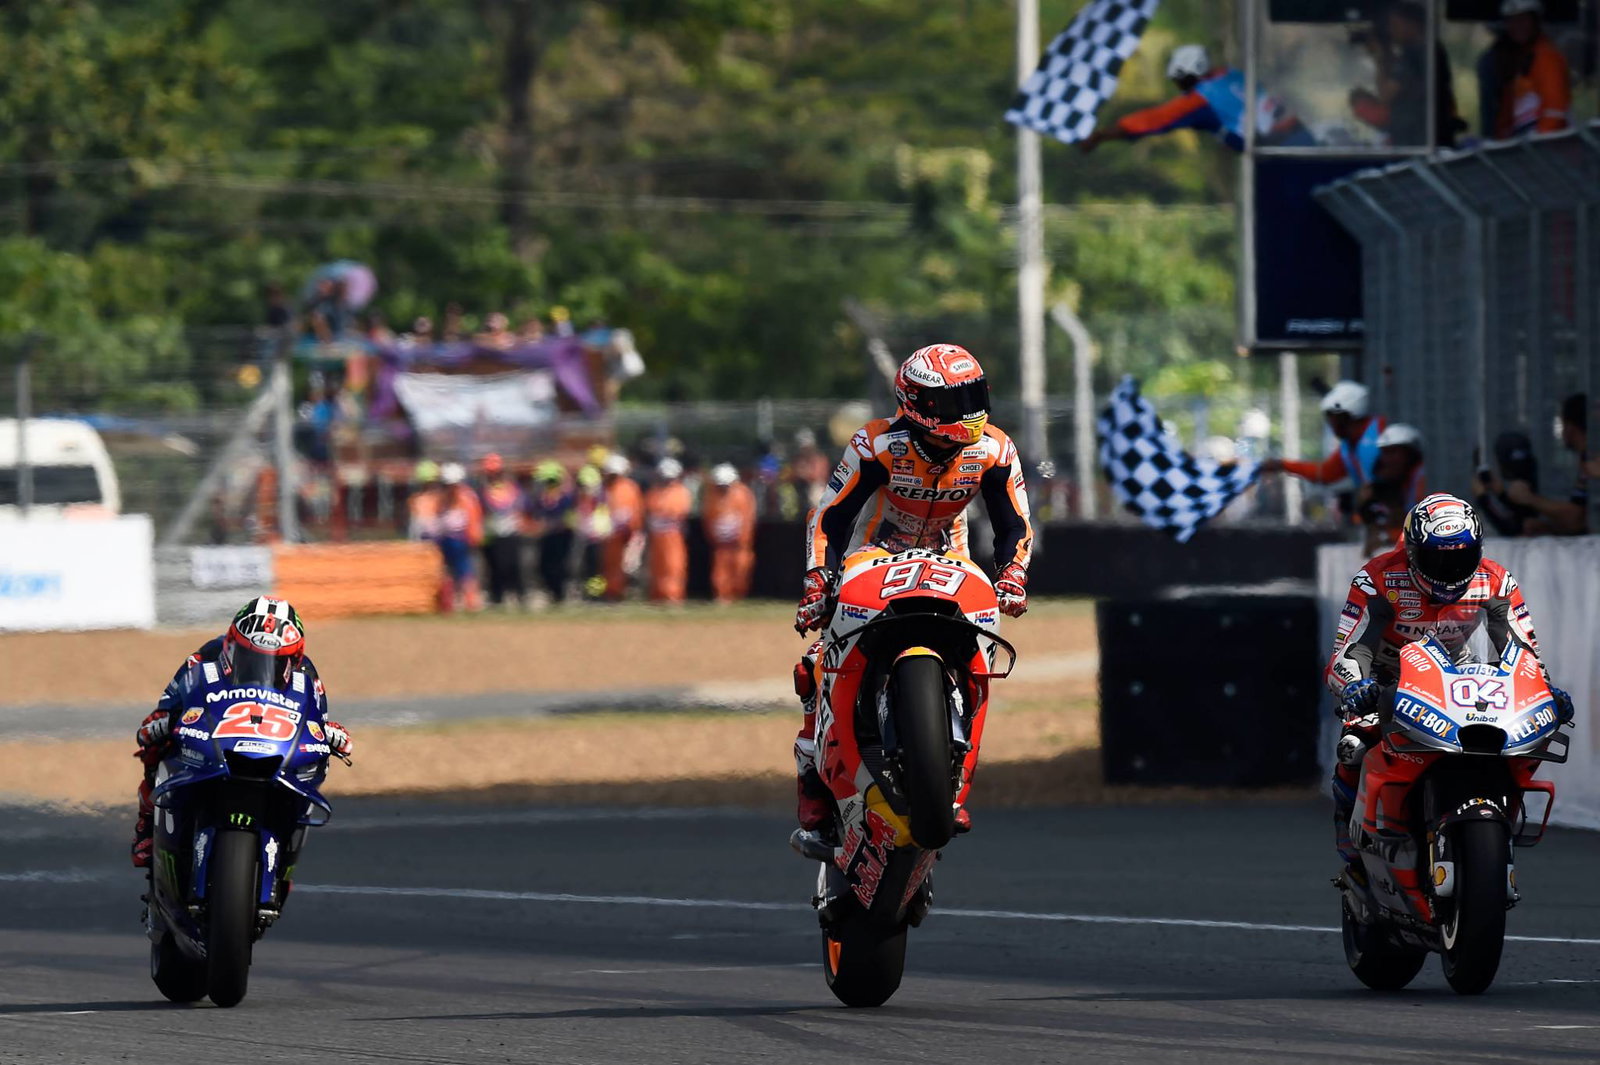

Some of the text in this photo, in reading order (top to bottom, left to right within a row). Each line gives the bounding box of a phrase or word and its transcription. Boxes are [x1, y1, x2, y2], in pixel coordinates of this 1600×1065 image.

[892, 475, 913, 484] Allianz
[954, 476, 980, 485] HRC
[893, 486, 974, 501] REPSOL
[872, 551, 967, 569] REPSOL
[880, 561, 967, 599] 93
[842, 605, 869, 620] HRC
[974, 611, 995, 624] HRC
[1460, 665, 1498, 677] valsir
[229, 688, 300, 710] movistar
[1452, 677, 1508, 709] 04
[212, 701, 301, 741] 25
[1396, 698, 1454, 738] FLEX-BOX
[1465, 713, 1498, 723] Unibat
[1513, 706, 1557, 741] FLEX-BOX
[180, 727, 210, 741] ENEOS
[305, 744, 331, 753] ENEOS
